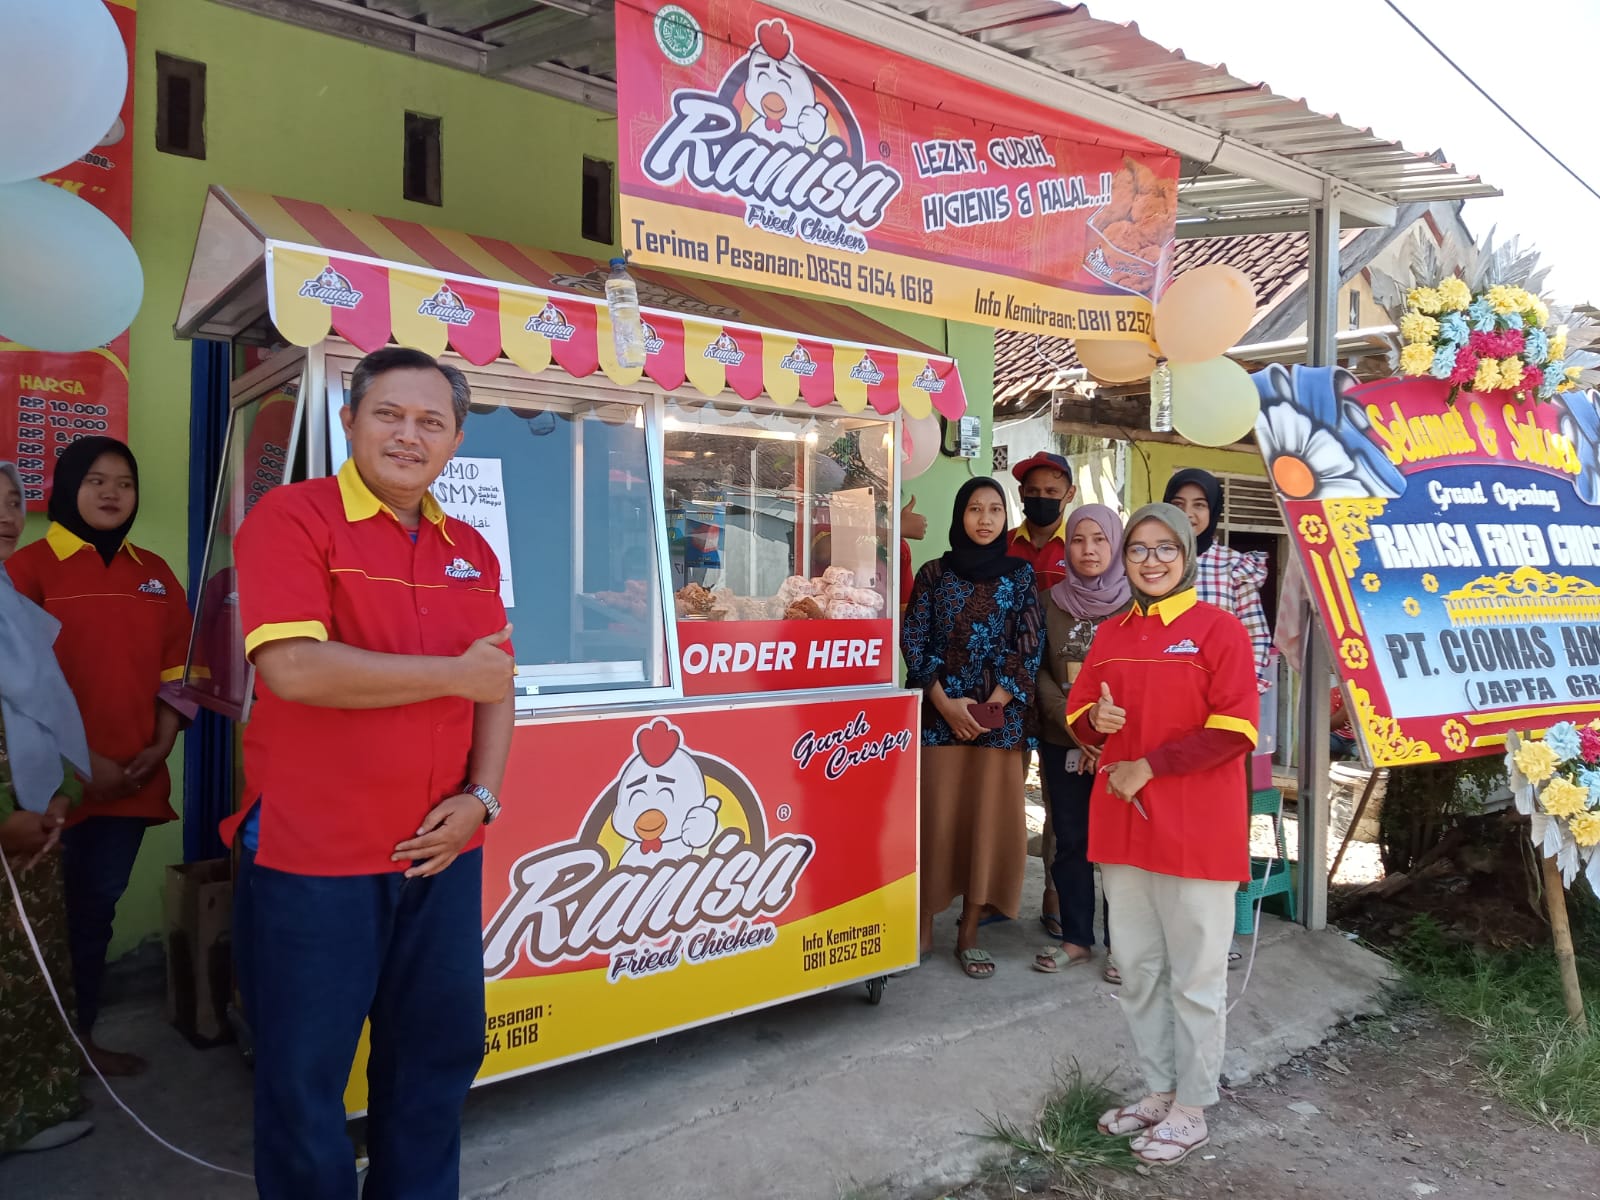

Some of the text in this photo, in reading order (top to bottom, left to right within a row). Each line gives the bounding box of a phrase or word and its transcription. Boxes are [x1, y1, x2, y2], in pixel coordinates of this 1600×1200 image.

[644, 92, 900, 229] Ranisa
[913, 136, 1054, 176] LEZAT, GURIH,
[922, 185, 1010, 231] HIGIENIS
[748, 204, 866, 251] Fried Chicken
[631, 218, 933, 305] Terima Pesanan: 0859 5154 1618
[299, 280, 361, 304] Ranisa
[418, 299, 473, 321] Ranisa
[525, 316, 575, 337] Ranisa
[974, 287, 1151, 335] Info Kemitraan: 0811 8252
[704, 344, 743, 362] Ranisa
[781, 356, 816, 373] Ranisa
[19, 374, 85, 395] HARGA
[850, 366, 884, 382] Ranisa
[913, 375, 945, 390] Ranisa
[50, 401, 107, 415] 10.000
[50, 416, 107, 431] 10.000
[1366, 401, 1476, 465] Selamat
[1428, 480, 1560, 512] Grand Opening
[1370, 523, 1482, 568] RANISA
[1475, 524, 1550, 566] FRIED
[683, 639, 882, 674] ORDER HERE
[1385, 632, 1441, 679] PT.
[1439, 626, 1556, 674] CIOMAS
[1566, 674, 1600, 698] GR
[793, 711, 869, 768] Gurih
[826, 728, 911, 780] Crispy
[483, 834, 815, 977] Ranisa
[612, 921, 774, 980] Fried Chicken
[802, 933, 823, 952] Info
[803, 937, 881, 971] 0811 8252 628
[485, 1004, 543, 1030] esanan
[507, 1023, 538, 1050] 1618
